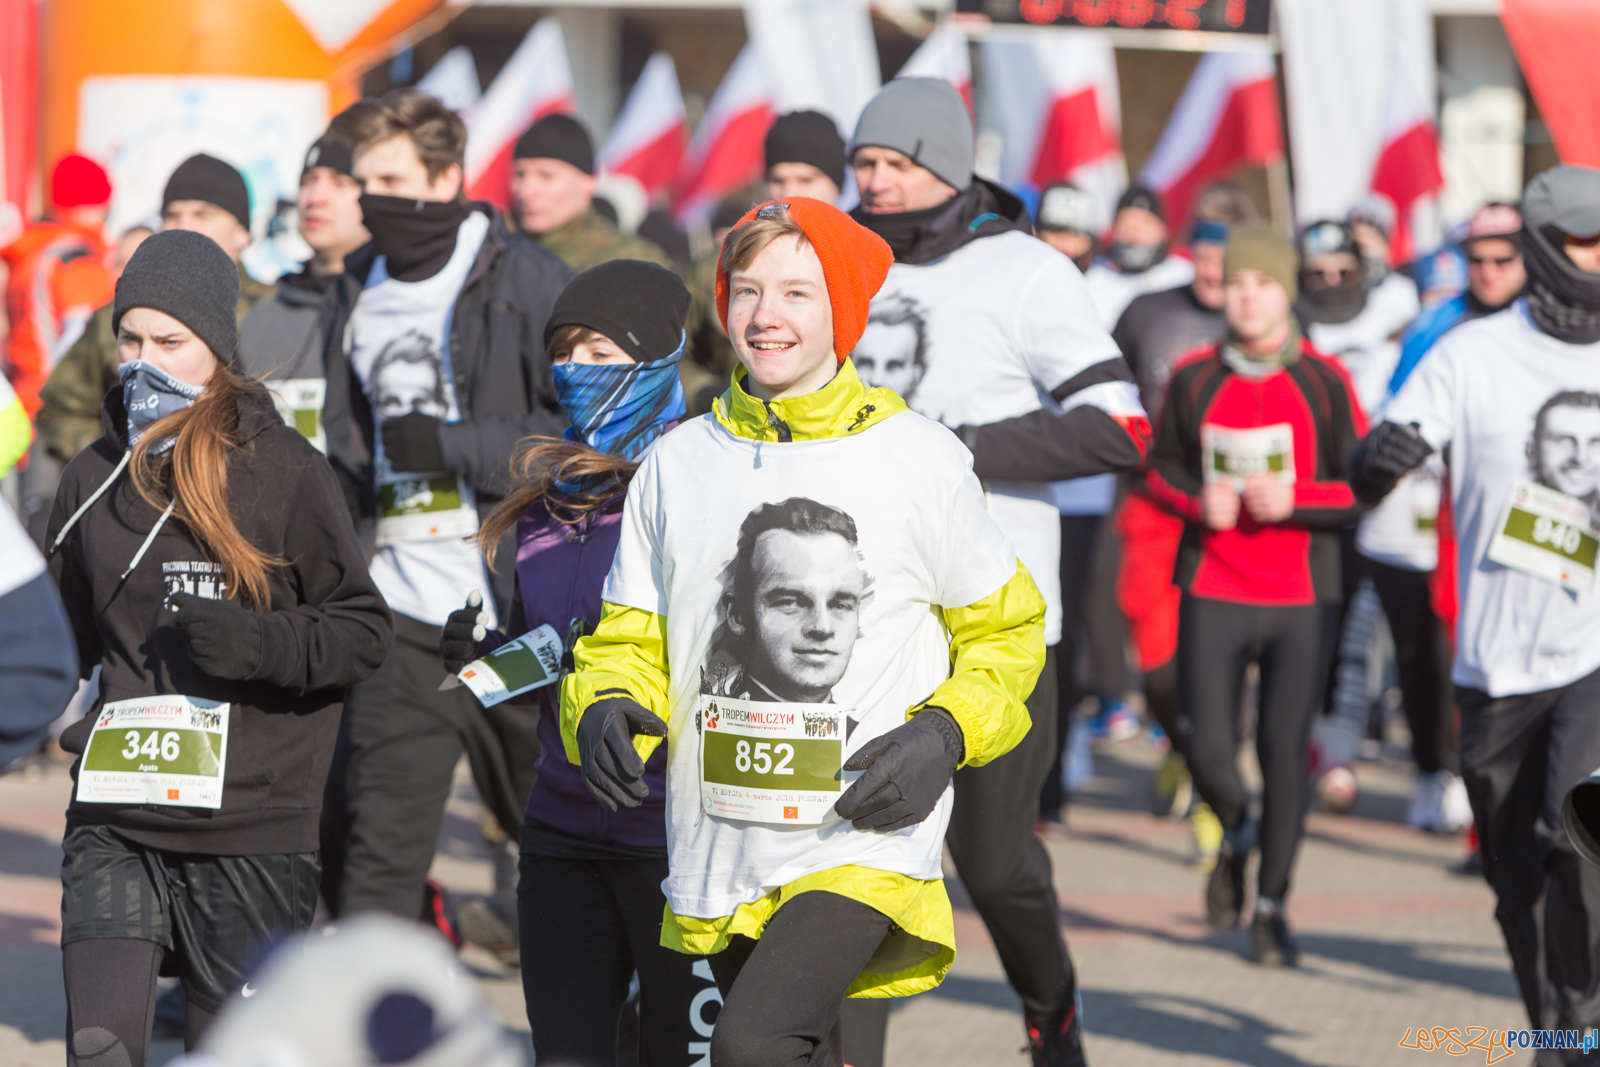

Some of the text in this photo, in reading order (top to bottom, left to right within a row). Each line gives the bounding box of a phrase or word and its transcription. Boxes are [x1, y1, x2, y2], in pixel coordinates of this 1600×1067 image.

[1532, 516, 1581, 555] 940
[116, 705, 182, 717] TROPEMWILCZYM
[722, 707, 795, 725] TROPEMWILCZYM
[122, 730, 181, 762] 346
[735, 740, 795, 775] 852
[138, 763, 158, 773] Agata
[712, 787, 719, 795] VI
[720, 788, 743, 798] EDYCJA
[776, 794, 794, 802] 2018
